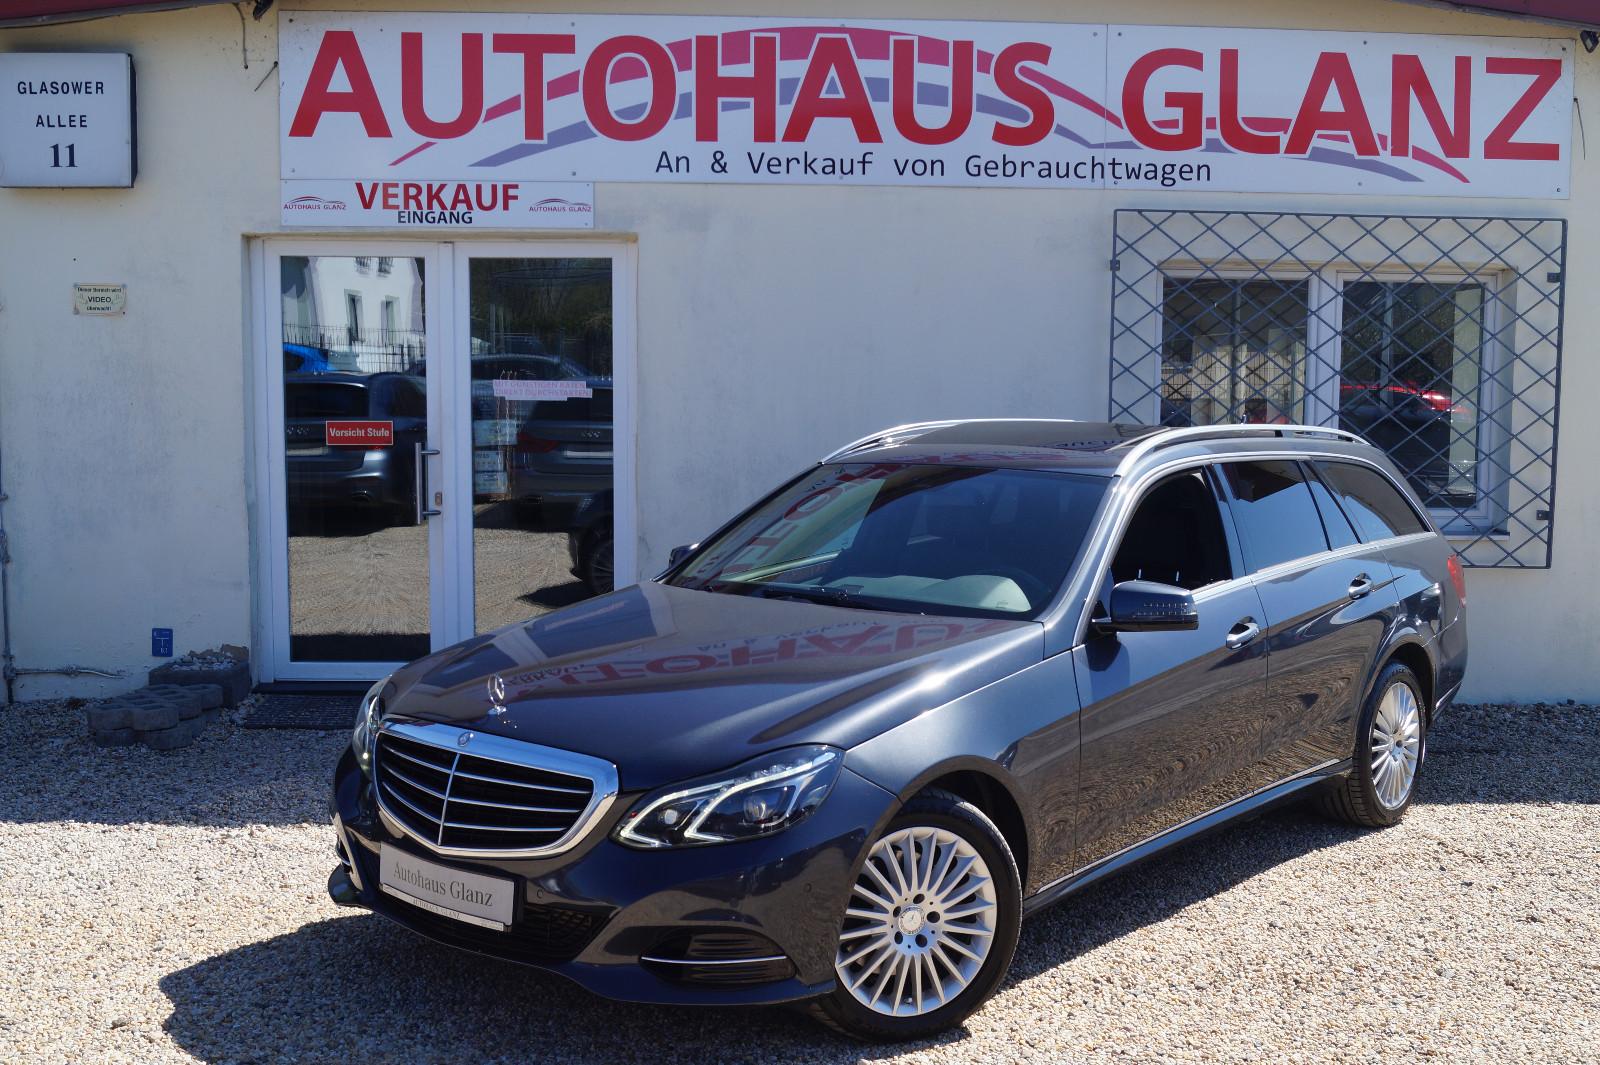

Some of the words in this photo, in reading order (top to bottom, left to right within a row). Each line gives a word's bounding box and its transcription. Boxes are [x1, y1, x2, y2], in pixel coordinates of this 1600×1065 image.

[17, 80, 104, 95] GLASOWER
[289, 30, 1056, 147] AUTOHAUS
[1122, 48, 1563, 161] GLANZ
[35, 114, 88, 128] ALLEE
[50, 143, 78, 168] 11
[655, 152, 691, 172] An
[711, 152, 729, 173] &
[747, 151, 874, 175] Verkauf
[894, 159, 945, 176] von
[965, 153, 1212, 187] Gebrauchtwagen
[355, 182, 519, 211] VERKAUF
[283, 203, 321, 211] AUTOHAUS
[529, 205, 567, 213] AUTOHAUS
[397, 210, 474, 225] EINGANG
[329, 427, 365, 437] Vorsicht
[367, 427, 390, 437] Stufe
[393, 861, 447, 896] Autohaus
[450, 879, 494, 907] Glanz
